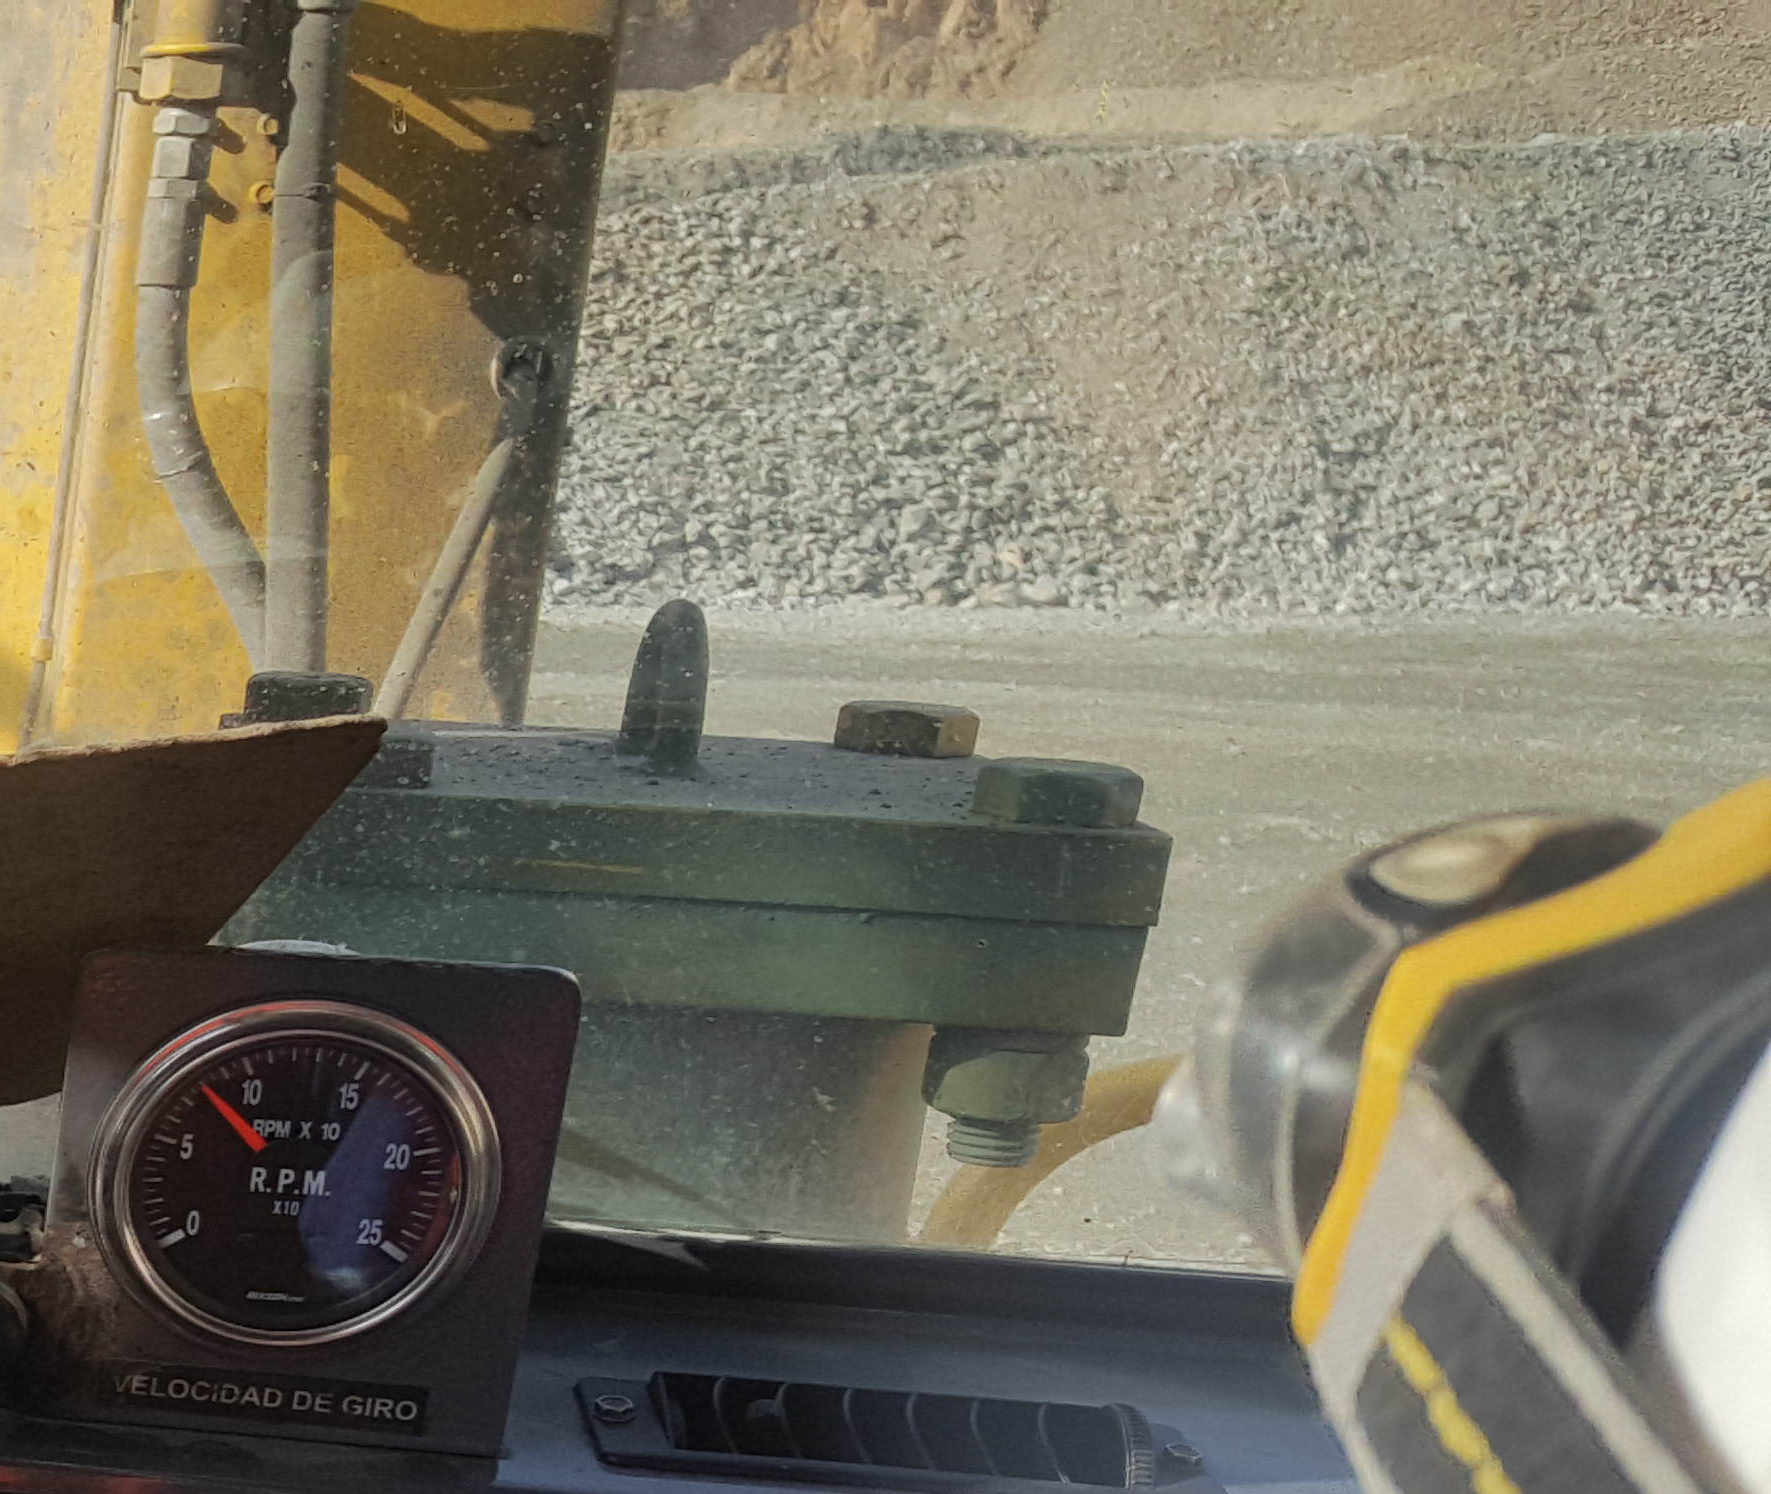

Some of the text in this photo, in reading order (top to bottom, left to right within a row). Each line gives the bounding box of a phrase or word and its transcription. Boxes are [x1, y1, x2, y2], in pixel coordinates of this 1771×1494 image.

[241, 1081, 261, 1106] 10
[339, 1084, 358, 1110] 15
[252, 1119, 341, 1141] RPM X 10
[180, 1134, 194, 1160] 5
[384, 1143, 410, 1170] 20
[249, 1166, 331, 1197] R.P.M.
[186, 1212, 200, 1237] 0
[357, 1219, 383, 1245] 25
[114, 1372, 418, 1421] VELOCIDAD DE GIRO
